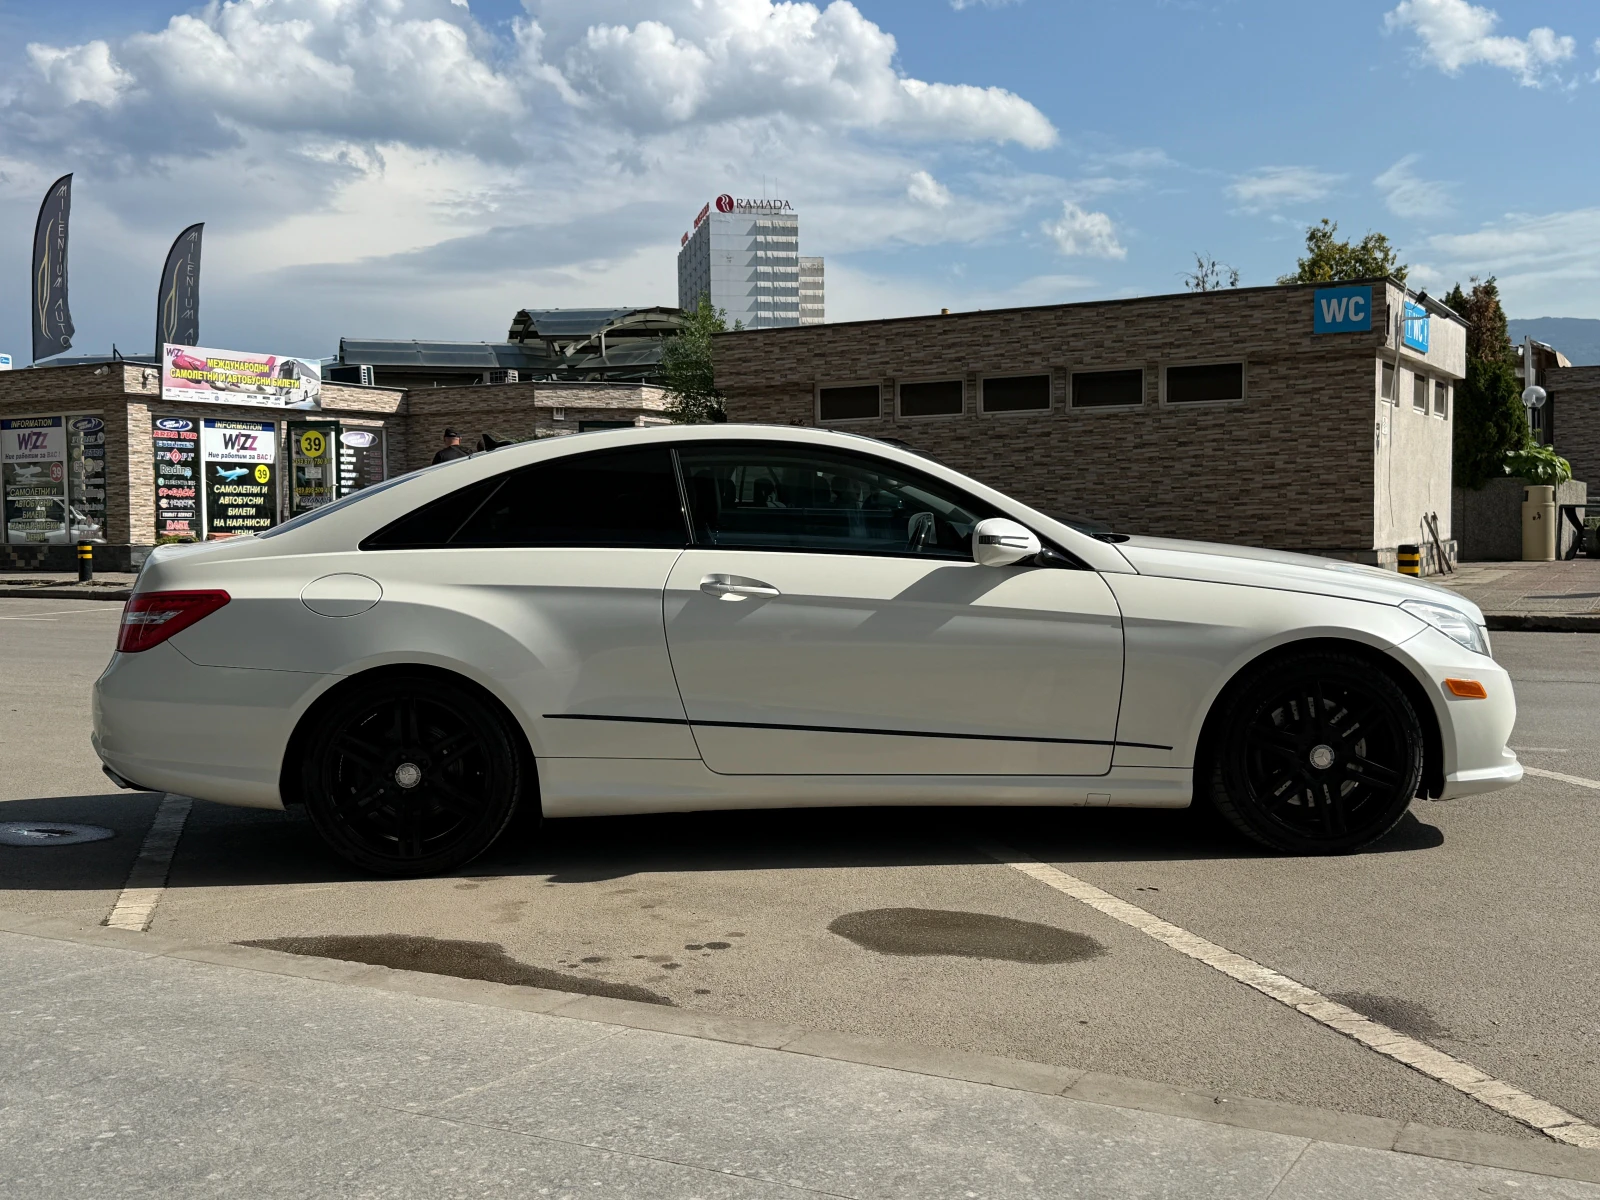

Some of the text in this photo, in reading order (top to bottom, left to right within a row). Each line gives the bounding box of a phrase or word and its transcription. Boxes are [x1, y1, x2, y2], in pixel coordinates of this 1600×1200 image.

[1320, 296, 1365, 324] WC
[206, 358, 270, 373] МЕЖДУНАРОДНИ
[169, 368, 300, 389] САМОЛЕТНИ И АВТОБУСНИ БИЛЕТИ
[11, 418, 52, 428] INFORMATION
[215, 420, 263, 431] INFORMATION
[153, 430, 198, 440] ARDA TUR
[304, 437, 322, 452] 39
[46, 451, 58, 459] ВАС
[208, 451, 220, 459] Ние
[221, 452, 247, 460] работим
[256, 453, 269, 461] ВАС
[52, 466, 62, 478] 39
[257, 469, 268, 479] 39
[10, 487, 57, 496] САМОЛЕТНИ И
[213, 484, 268, 494] САМОЛЕТНИ И
[15, 499, 53, 508] АВТОБУСНИ
[218, 496, 264, 505] АВТОБУСНИ
[22, 510, 47, 519] БИЛЕТИ
[227, 507, 256, 516] БИЛЕТИ
[213, 518, 271, 527] НА НАЙ-НИСКИ
